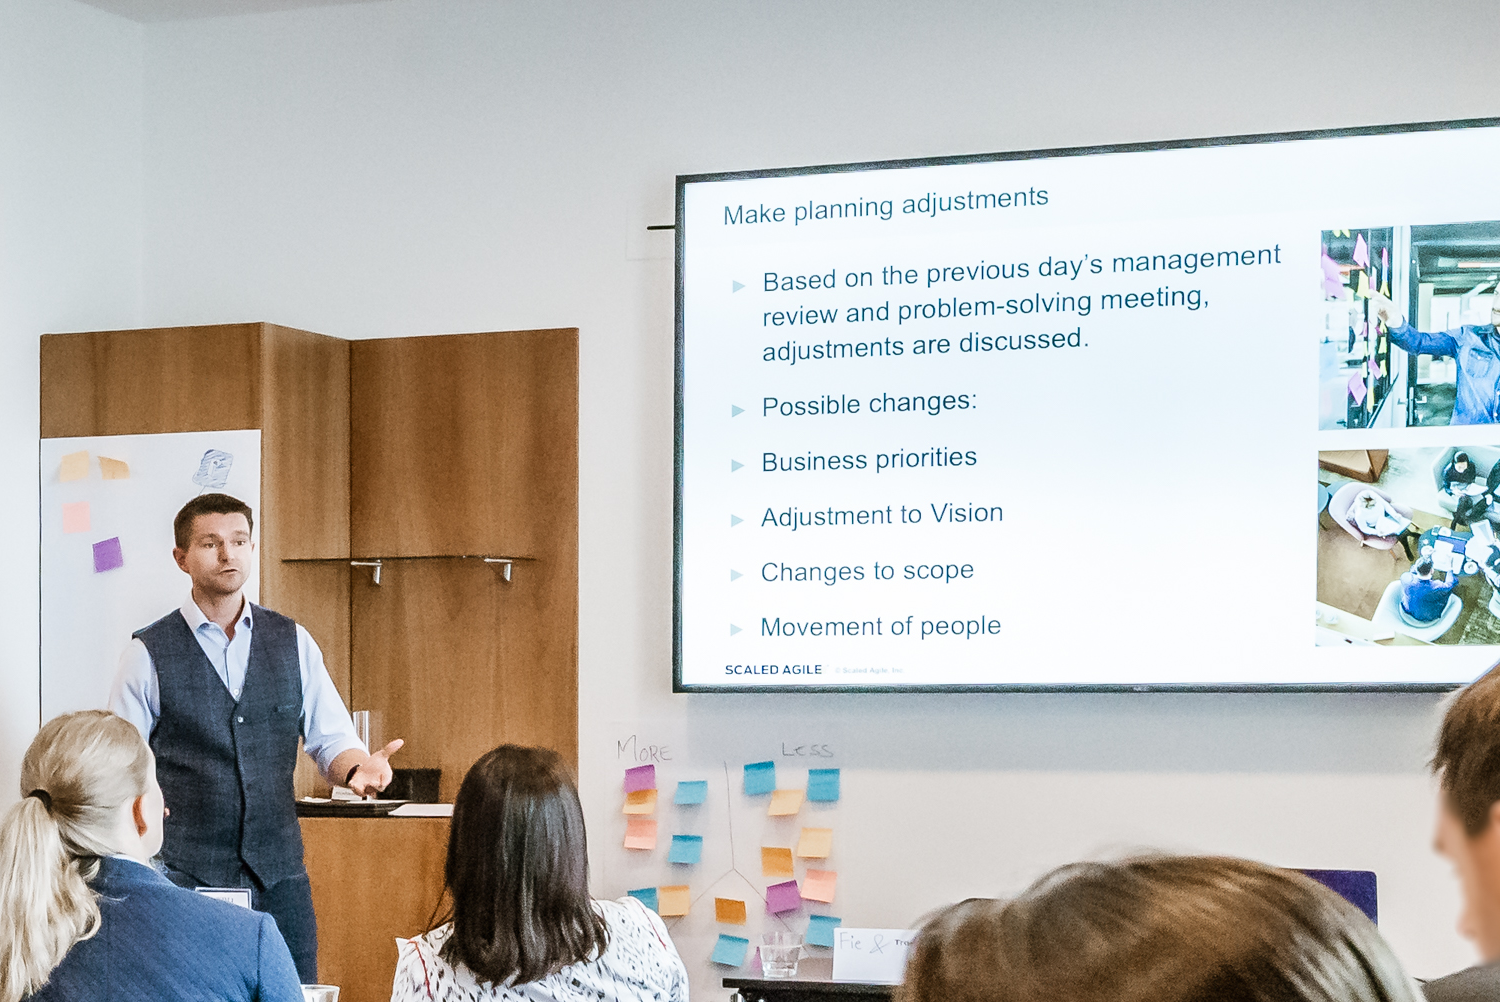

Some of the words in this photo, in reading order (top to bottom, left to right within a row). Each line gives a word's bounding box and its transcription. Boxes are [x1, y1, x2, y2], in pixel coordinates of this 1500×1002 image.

[724, 203, 786, 226] Make
[795, 196, 893, 226] planning
[902, 186, 1049, 218] adjustments
[764, 268, 836, 292] Based
[845, 271, 873, 288] on
[882, 265, 918, 286] the
[927, 260, 1030, 289] previous
[1113, 243, 1282, 275] management
[763, 305, 839, 327] review
[846, 300, 889, 323] and
[898, 291, 1091, 324] problem-solving
[1101, 285, 1210, 311] meeting,
[762, 336, 904, 366] adjustments
[912, 338, 951, 355] are
[959, 326, 1089, 353] discussed.
[762, 394, 861, 418] Possible
[869, 391, 977, 416] changes:
[762, 450, 868, 472] Business
[876, 446, 977, 474] priorities
[760, 505, 893, 532] Adjustment
[900, 505, 922, 525] to
[930, 502, 1003, 524] Vision
[761, 560, 865, 587] Changes
[873, 561, 895, 581] to
[903, 563, 974, 585] scope
[761, 616, 883, 638] Movement
[891, 615, 914, 637] of
[921, 615, 1001, 641] people
[725, 664, 779, 675] SCALED
[783, 664, 822, 675] AGILE
[842, 666, 867, 675] Scaled
[840, 932, 862, 950] Fie
